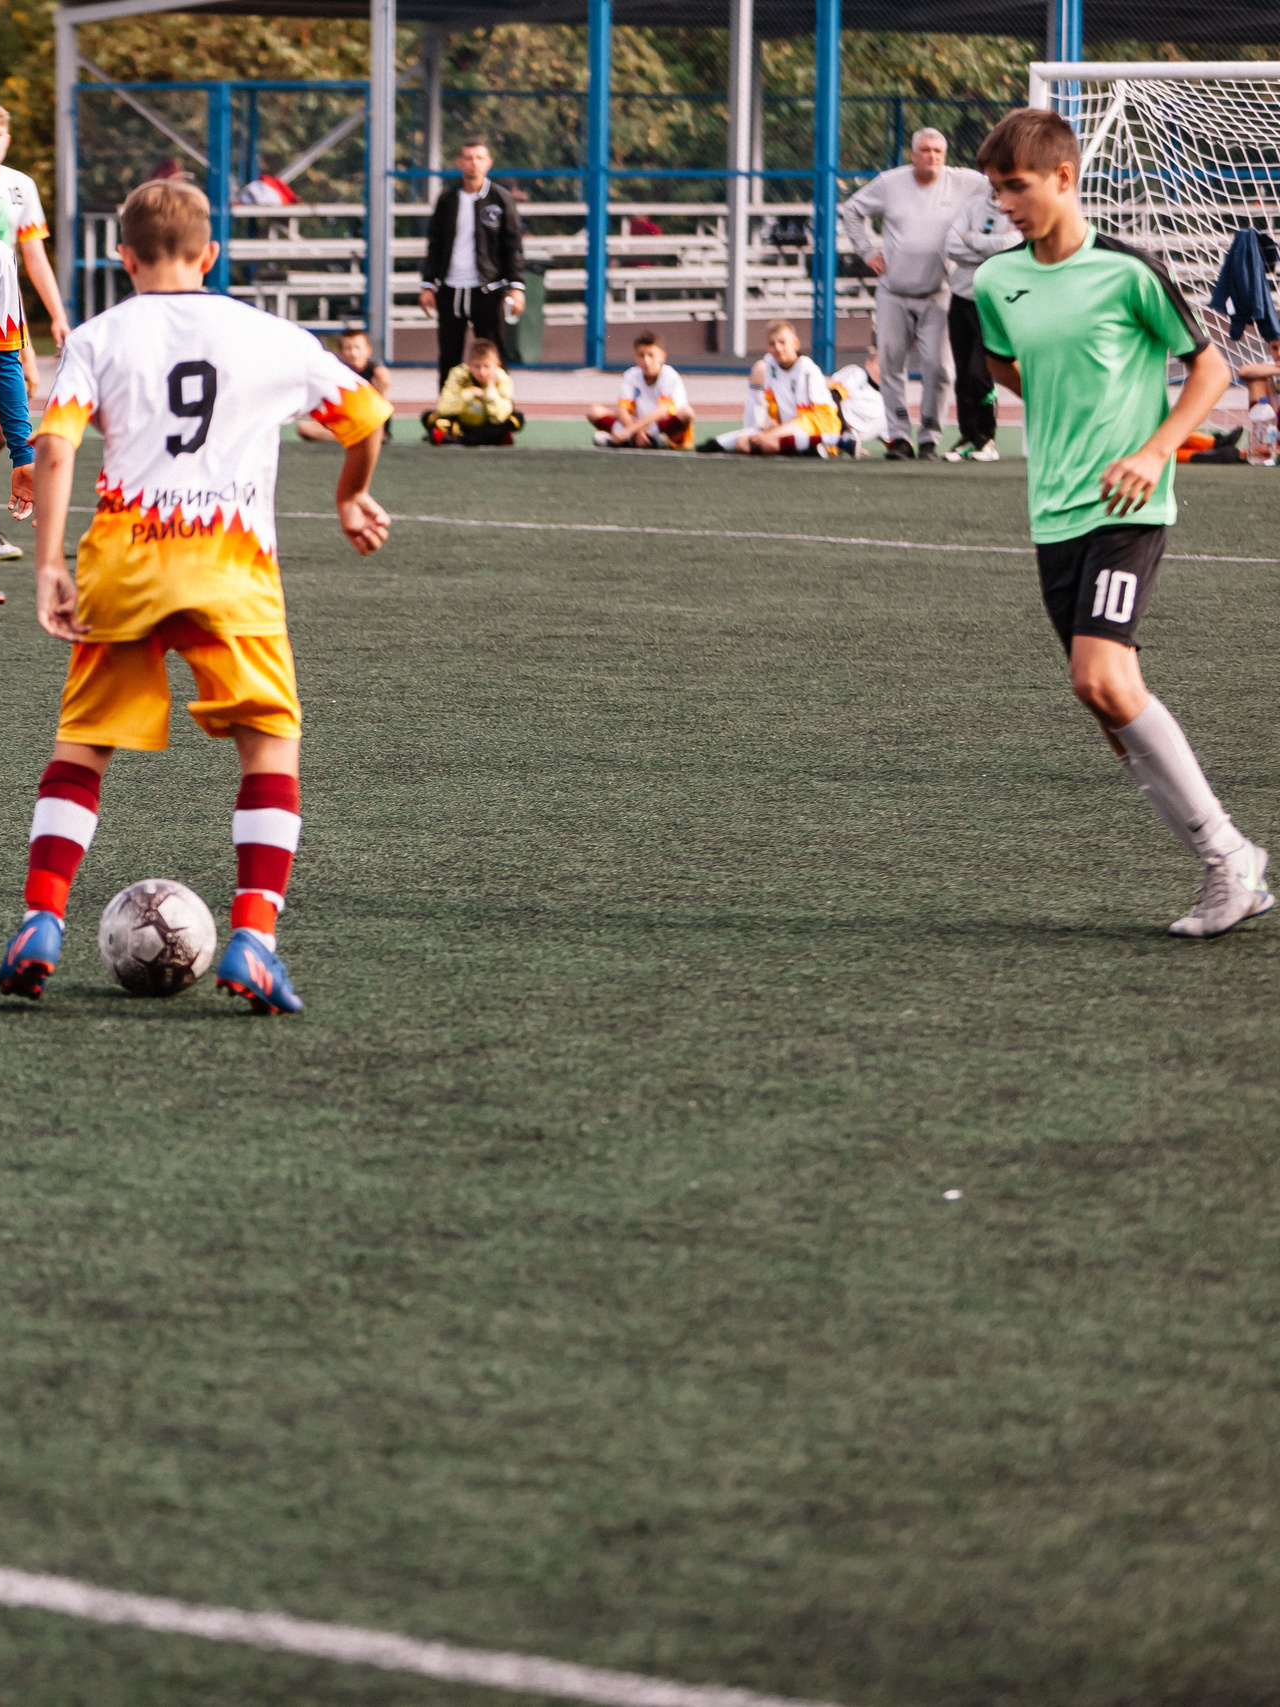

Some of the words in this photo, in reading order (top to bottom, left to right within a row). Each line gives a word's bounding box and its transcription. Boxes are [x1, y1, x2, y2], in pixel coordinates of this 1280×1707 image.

[165, 360, 217, 459] 9
[131, 515, 214, 546] РАЙОН
[1091, 568, 1138, 624] 10
